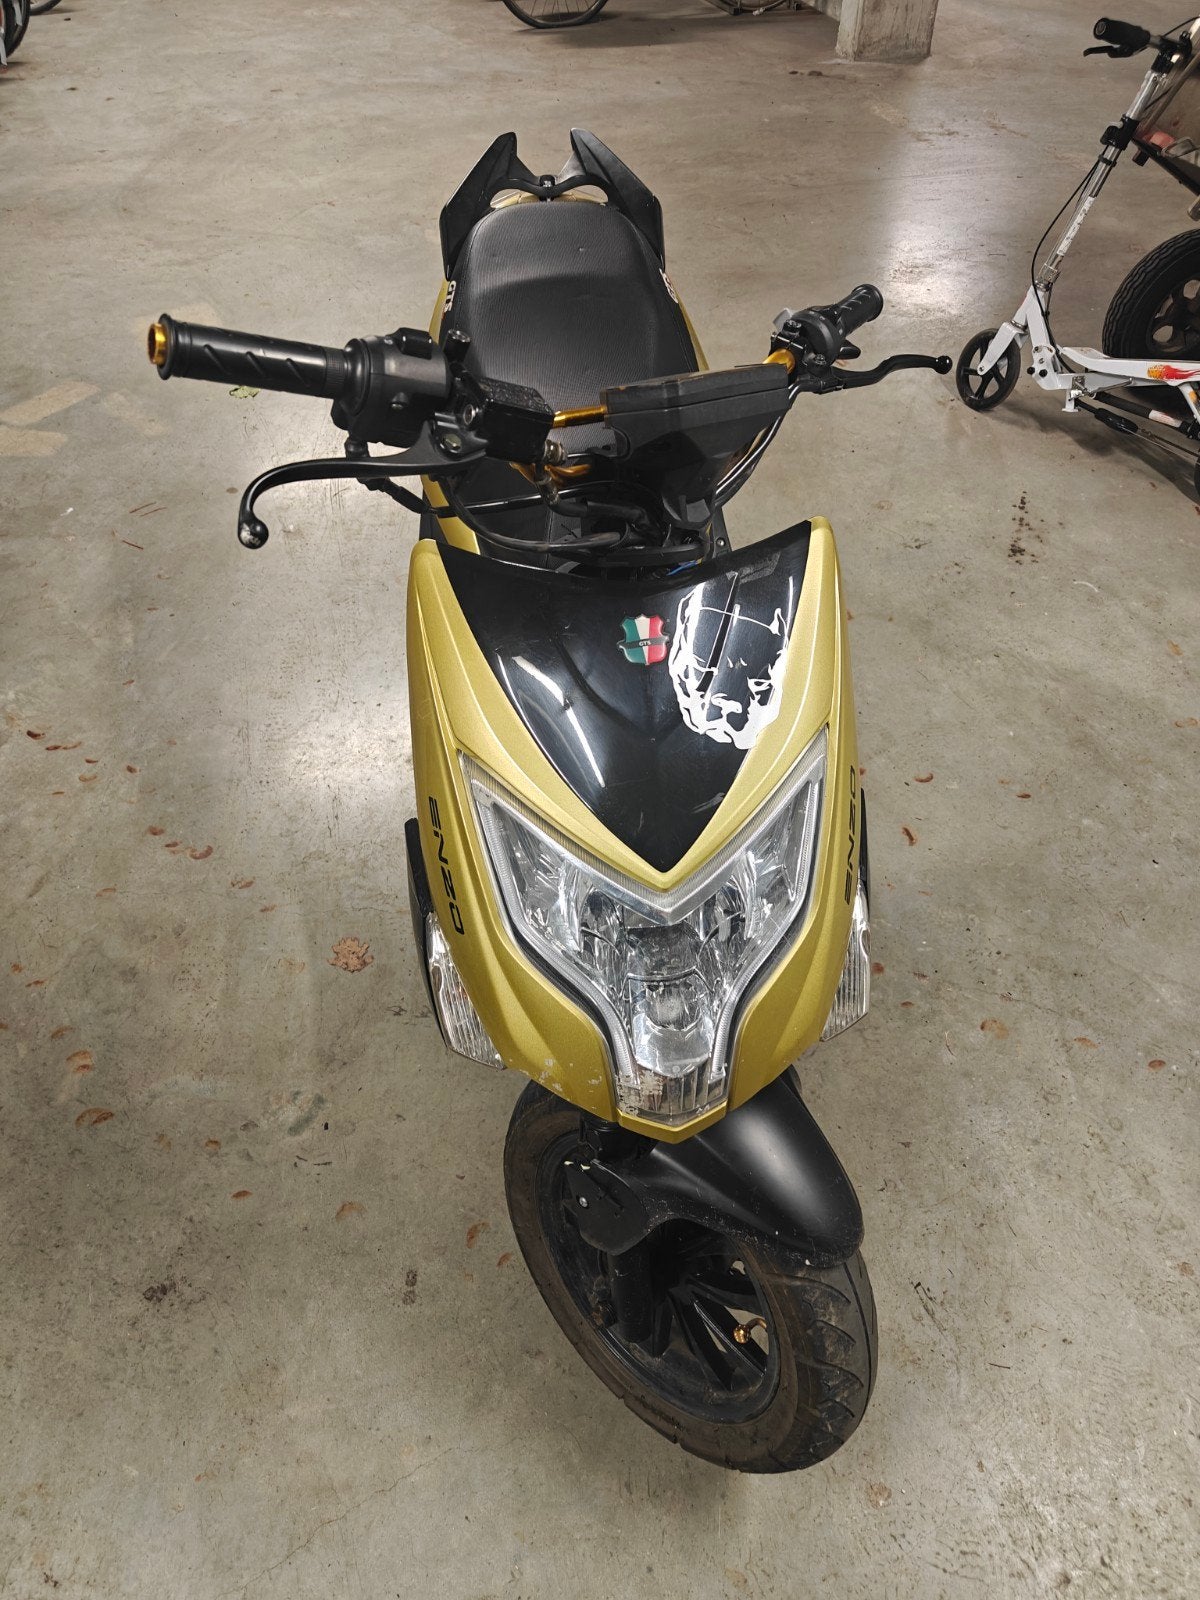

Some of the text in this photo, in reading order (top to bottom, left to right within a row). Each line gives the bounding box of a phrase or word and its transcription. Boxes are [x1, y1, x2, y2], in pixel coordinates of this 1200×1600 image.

[445, 280, 457, 312] GTS
[428, 796, 465, 935] ENZO
[844, 765, 856, 905] ENZO
